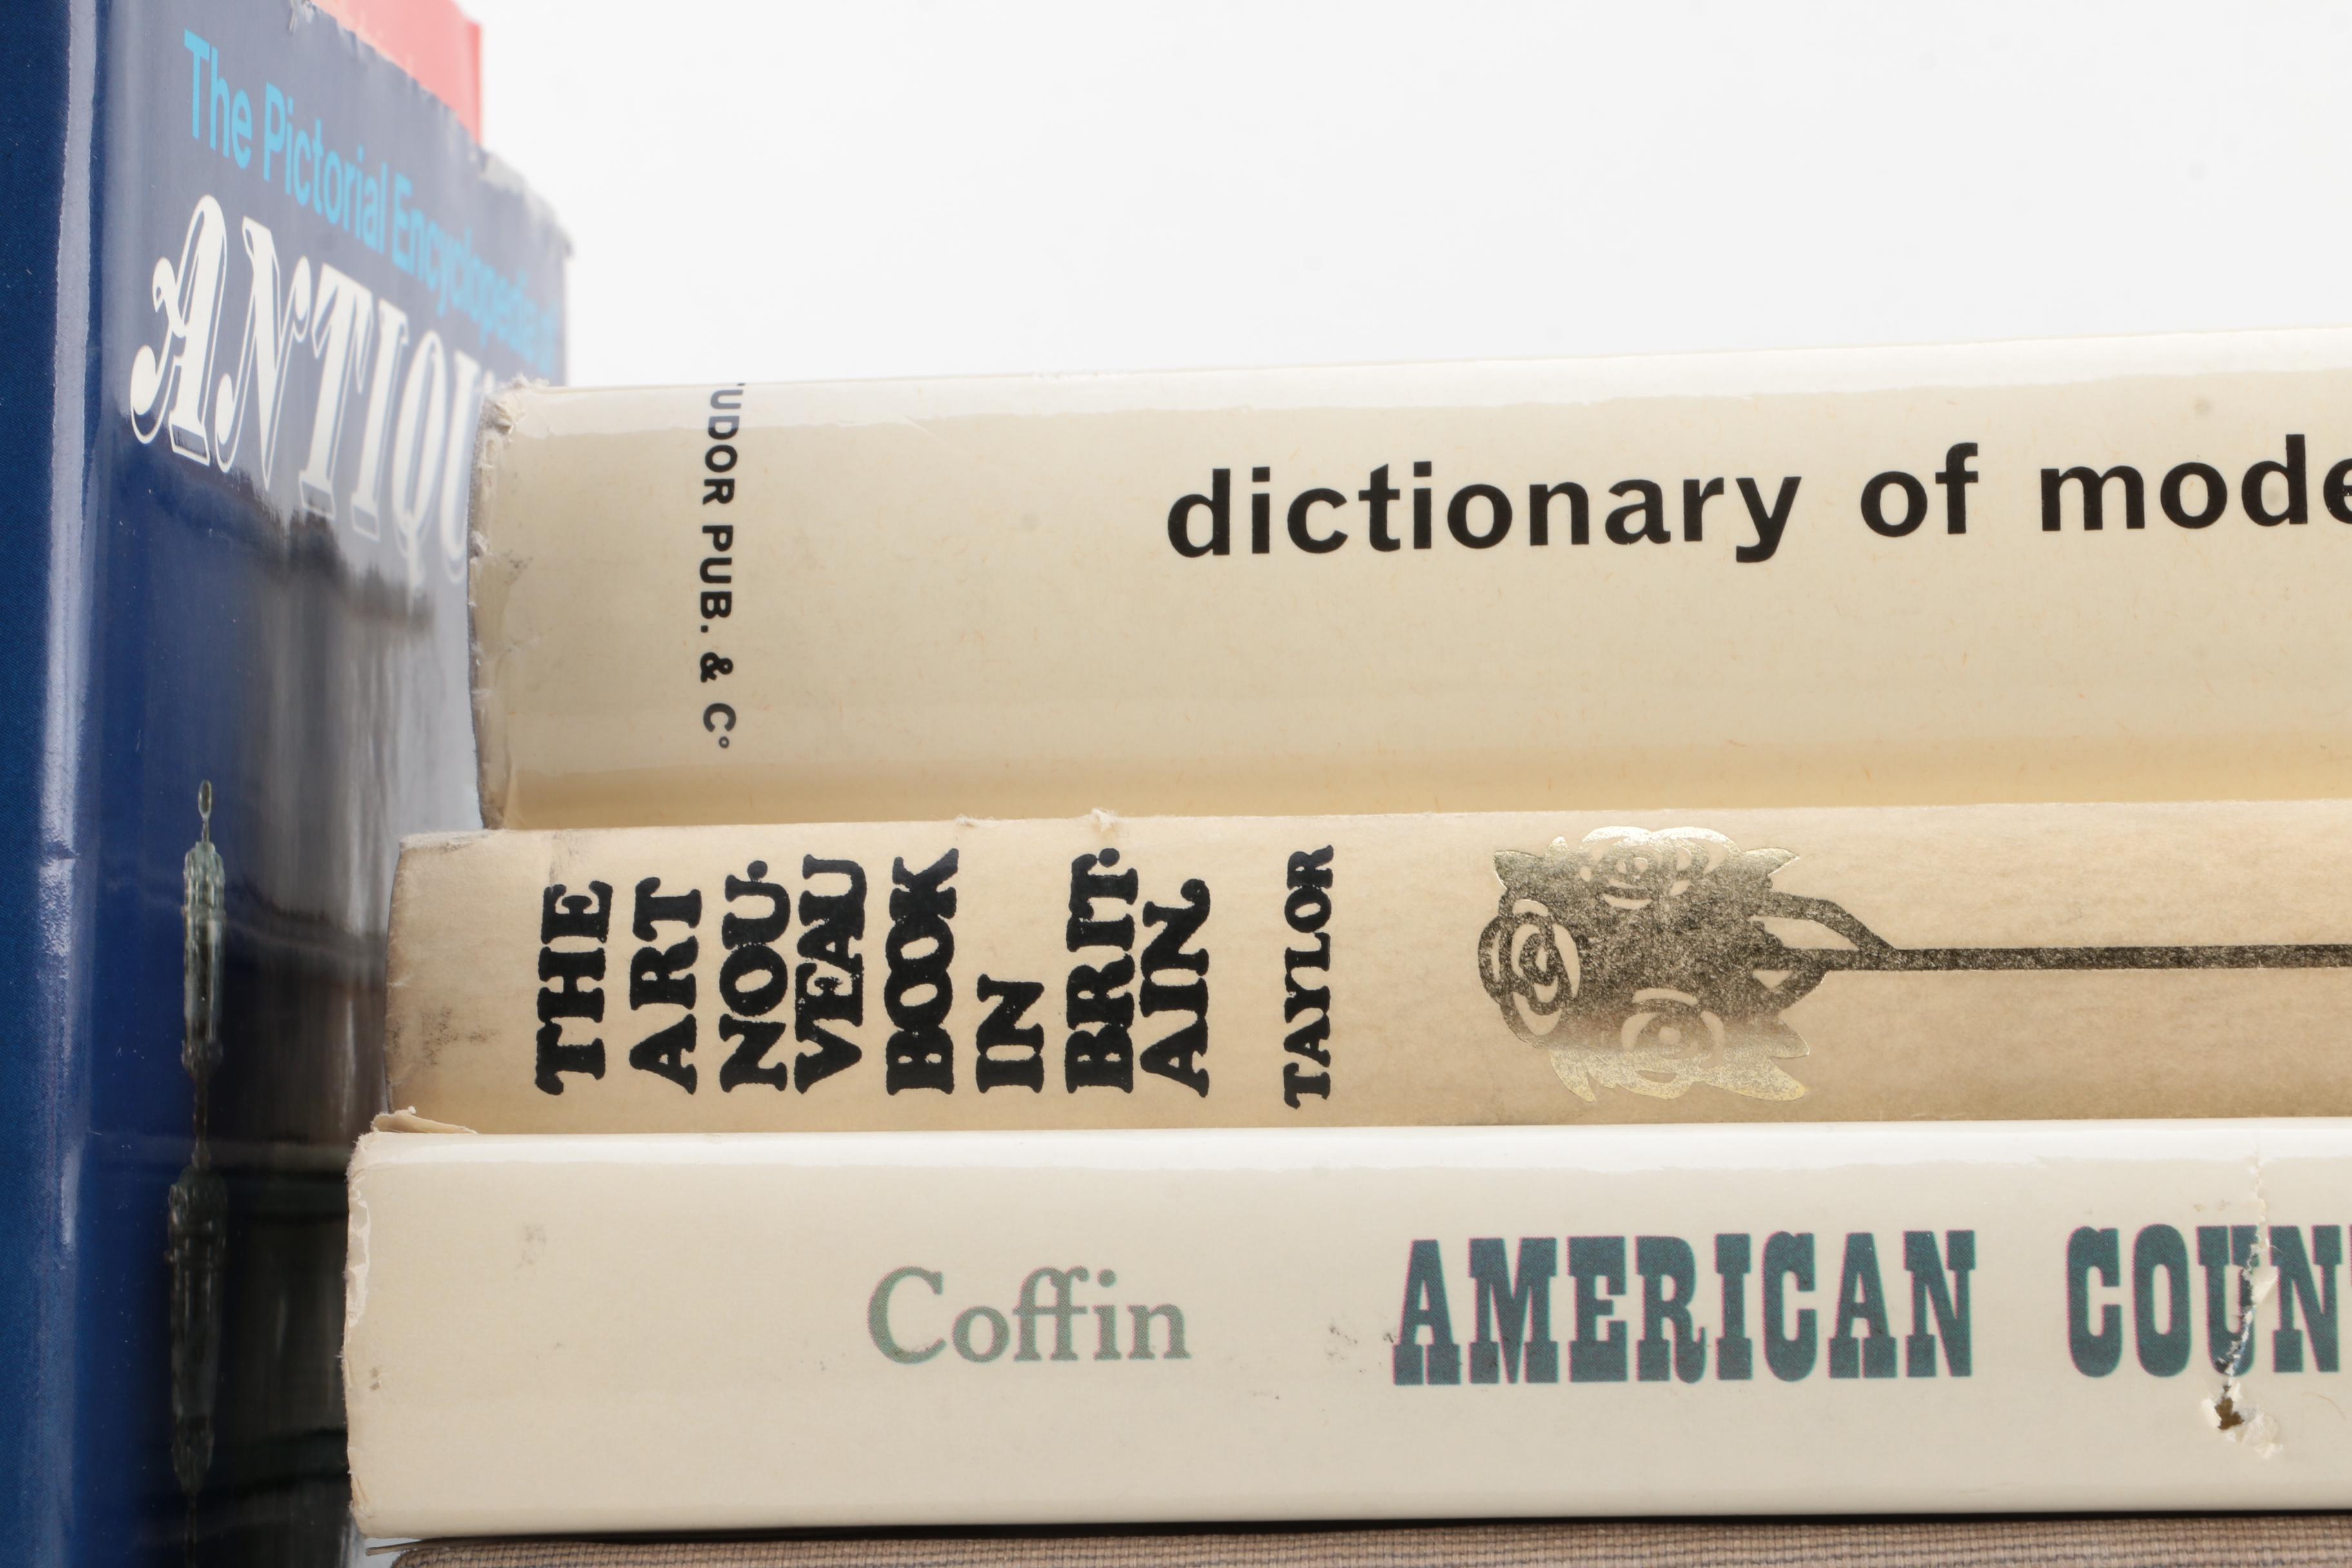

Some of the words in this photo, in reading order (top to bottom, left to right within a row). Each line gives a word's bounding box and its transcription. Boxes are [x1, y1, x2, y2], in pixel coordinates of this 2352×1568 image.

[183, 28, 253, 171] The
[263, 82, 388, 255] Pictorial
[701, 383, 745, 505] UDOR
[1168, 460, 1802, 564] dictionary
[1860, 442, 1979, 538] of
[699, 525, 734, 633] PUB.
[700, 651, 734, 683] &
[534, 880, 614, 1096] THE
[629, 876, 703, 1095] ART
[794, 854, 868, 1095] VEAU
[883, 848, 959, 1096] BOOK
[975, 974, 1045, 1094] IN
[1139, 878, 1211, 1098] AIN
[1282, 844, 1335, 1110] TAYLOR
[867, 1265, 1192, 1365] Coffin
[1393, 1229, 1976, 1386] AMERICAN
[2065, 1223, 2352, 1379] COUN
